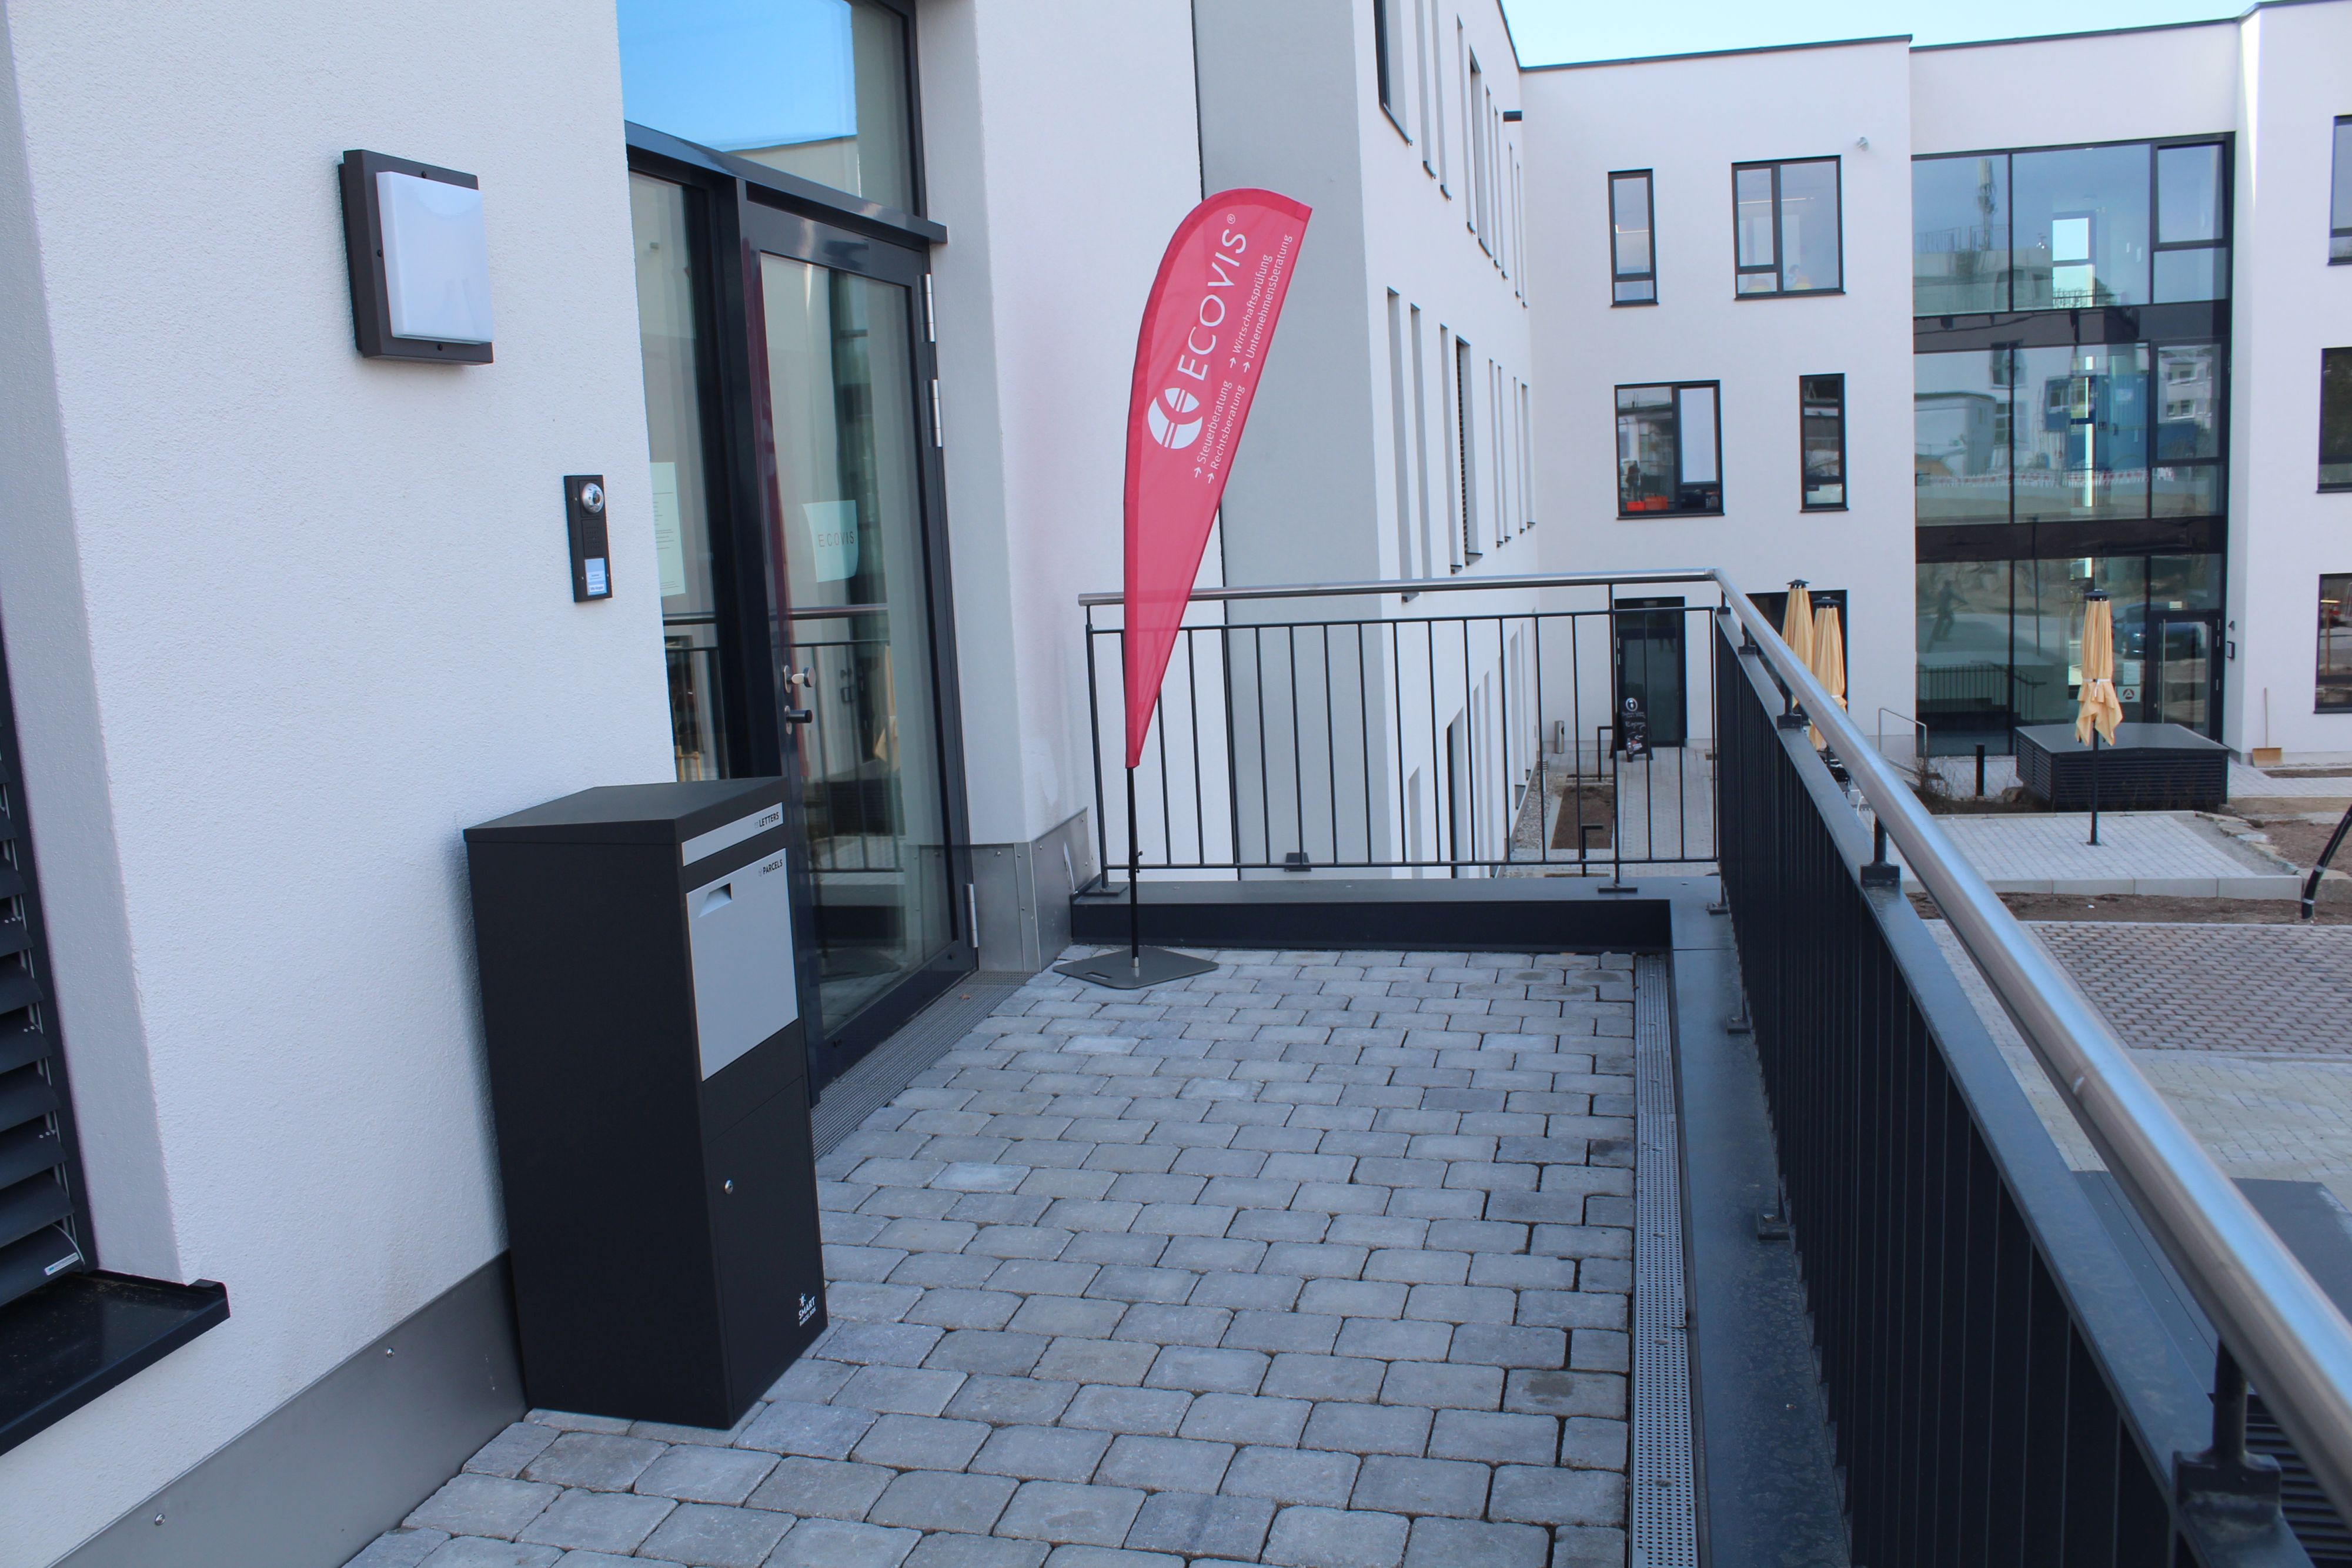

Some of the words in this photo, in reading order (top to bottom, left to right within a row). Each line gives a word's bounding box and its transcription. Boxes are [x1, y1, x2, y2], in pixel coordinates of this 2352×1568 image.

[1197, 380, 1232, 464] Steuerberatung
[1232, 254, 1272, 354] Wirtschaftsprüfung
[1210, 385, 1245, 470] Rechtsberatung
[1245, 234, 1292, 359] Unternehmensberatung
[818, 531, 854, 547] ECOVIS
[759, 811, 779, 828] LETTERS
[763, 859, 783, 875] PARCELS
[799, 1296, 815, 1320] SMART
